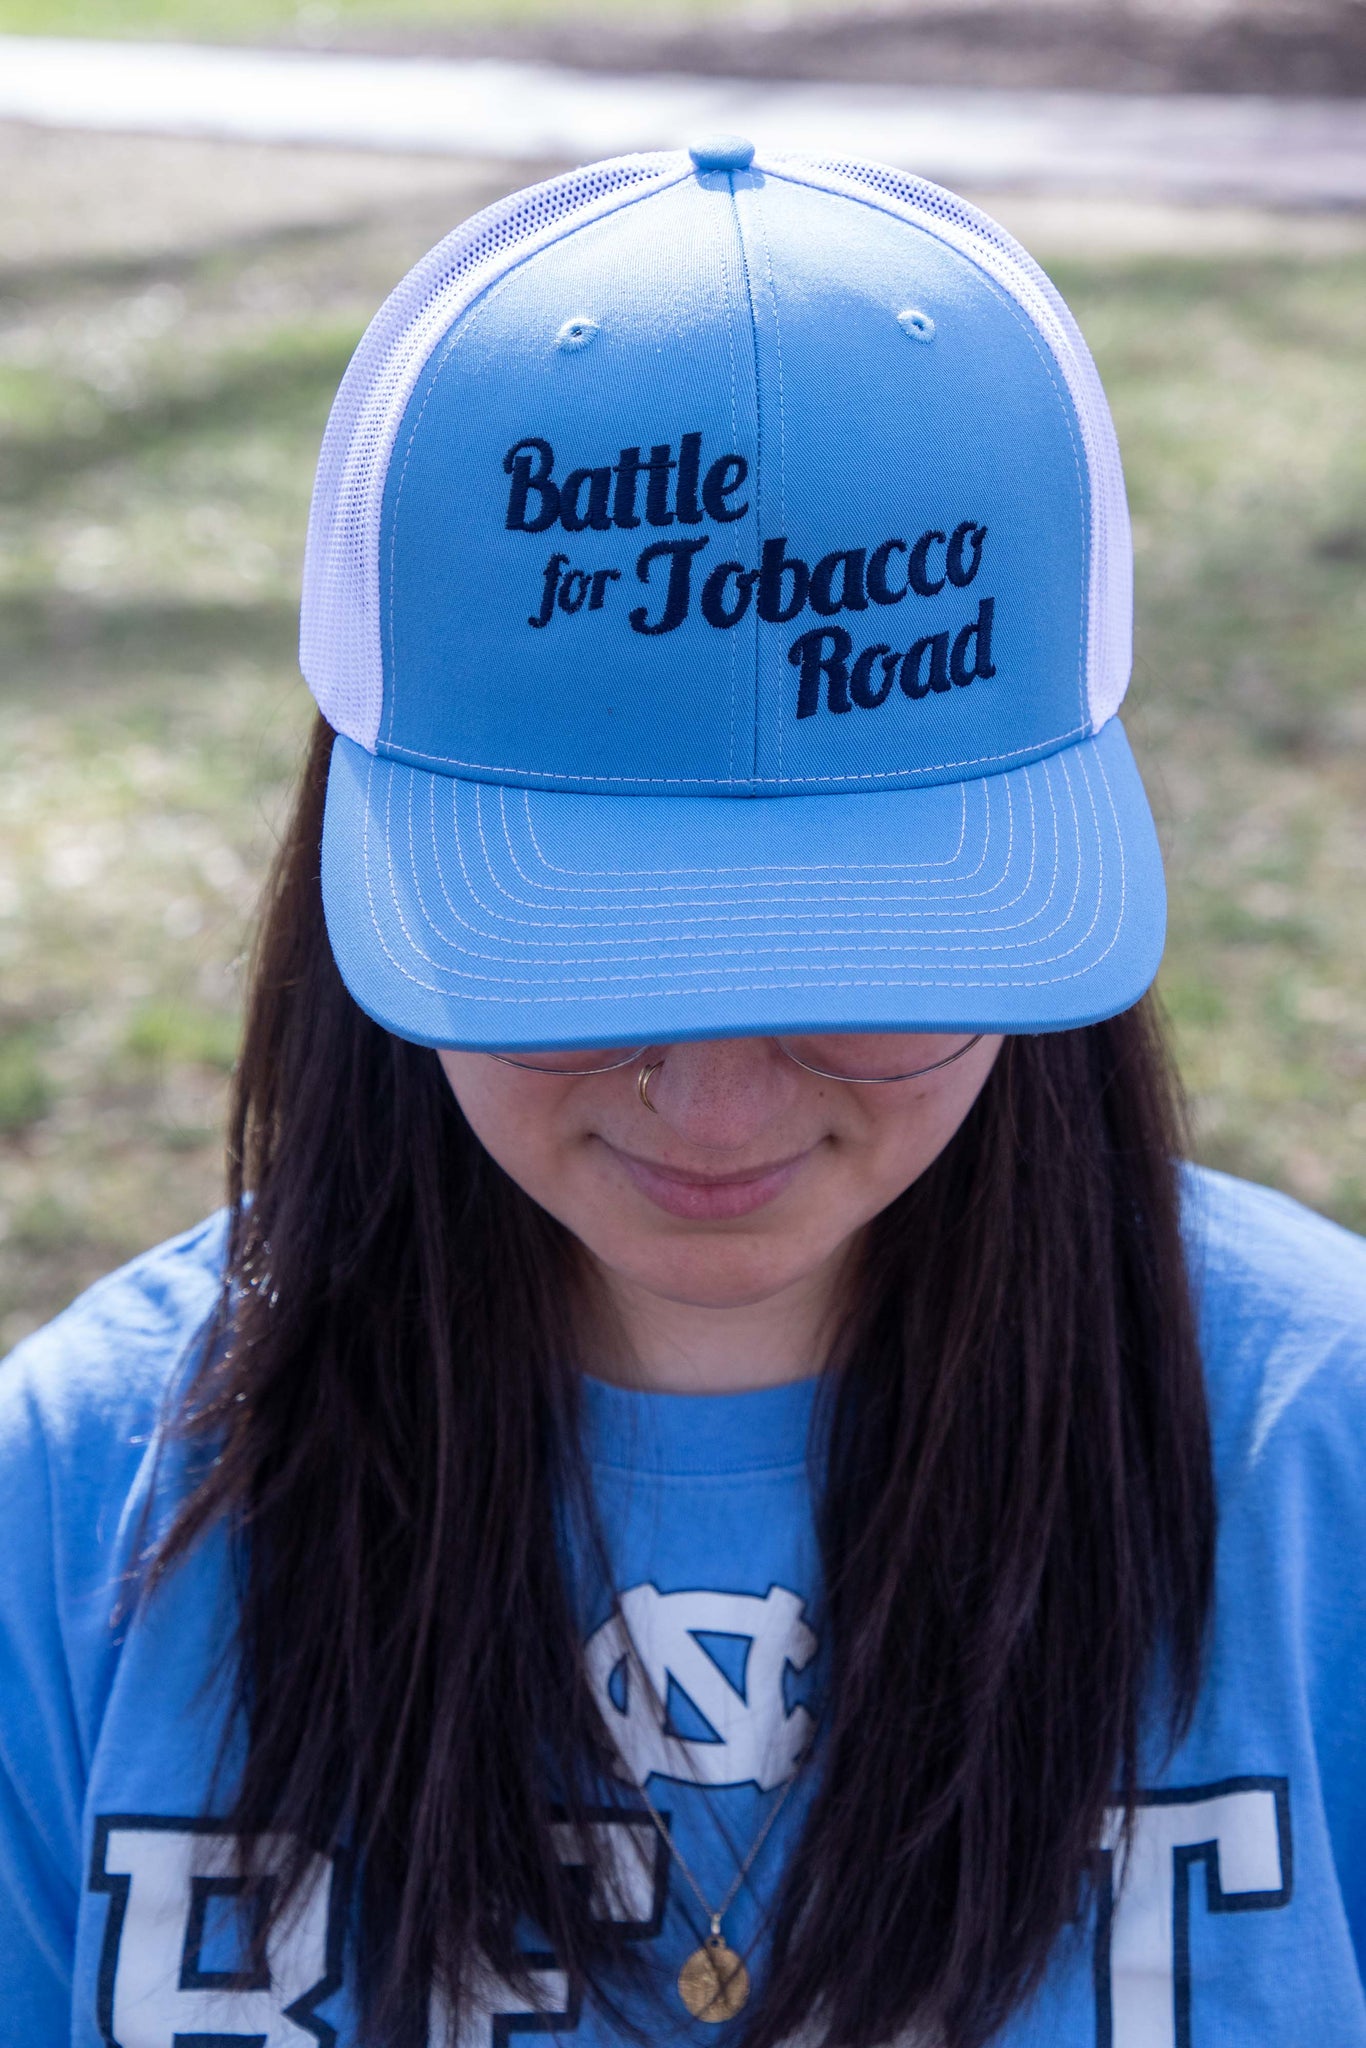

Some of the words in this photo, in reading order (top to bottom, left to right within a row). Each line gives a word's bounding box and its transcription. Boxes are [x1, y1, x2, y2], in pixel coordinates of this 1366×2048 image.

[503, 431, 748, 533] Battle
[528, 552, 620, 628] for
[629, 520, 987, 636] Tobacco
[787, 596, 996, 719] Road
